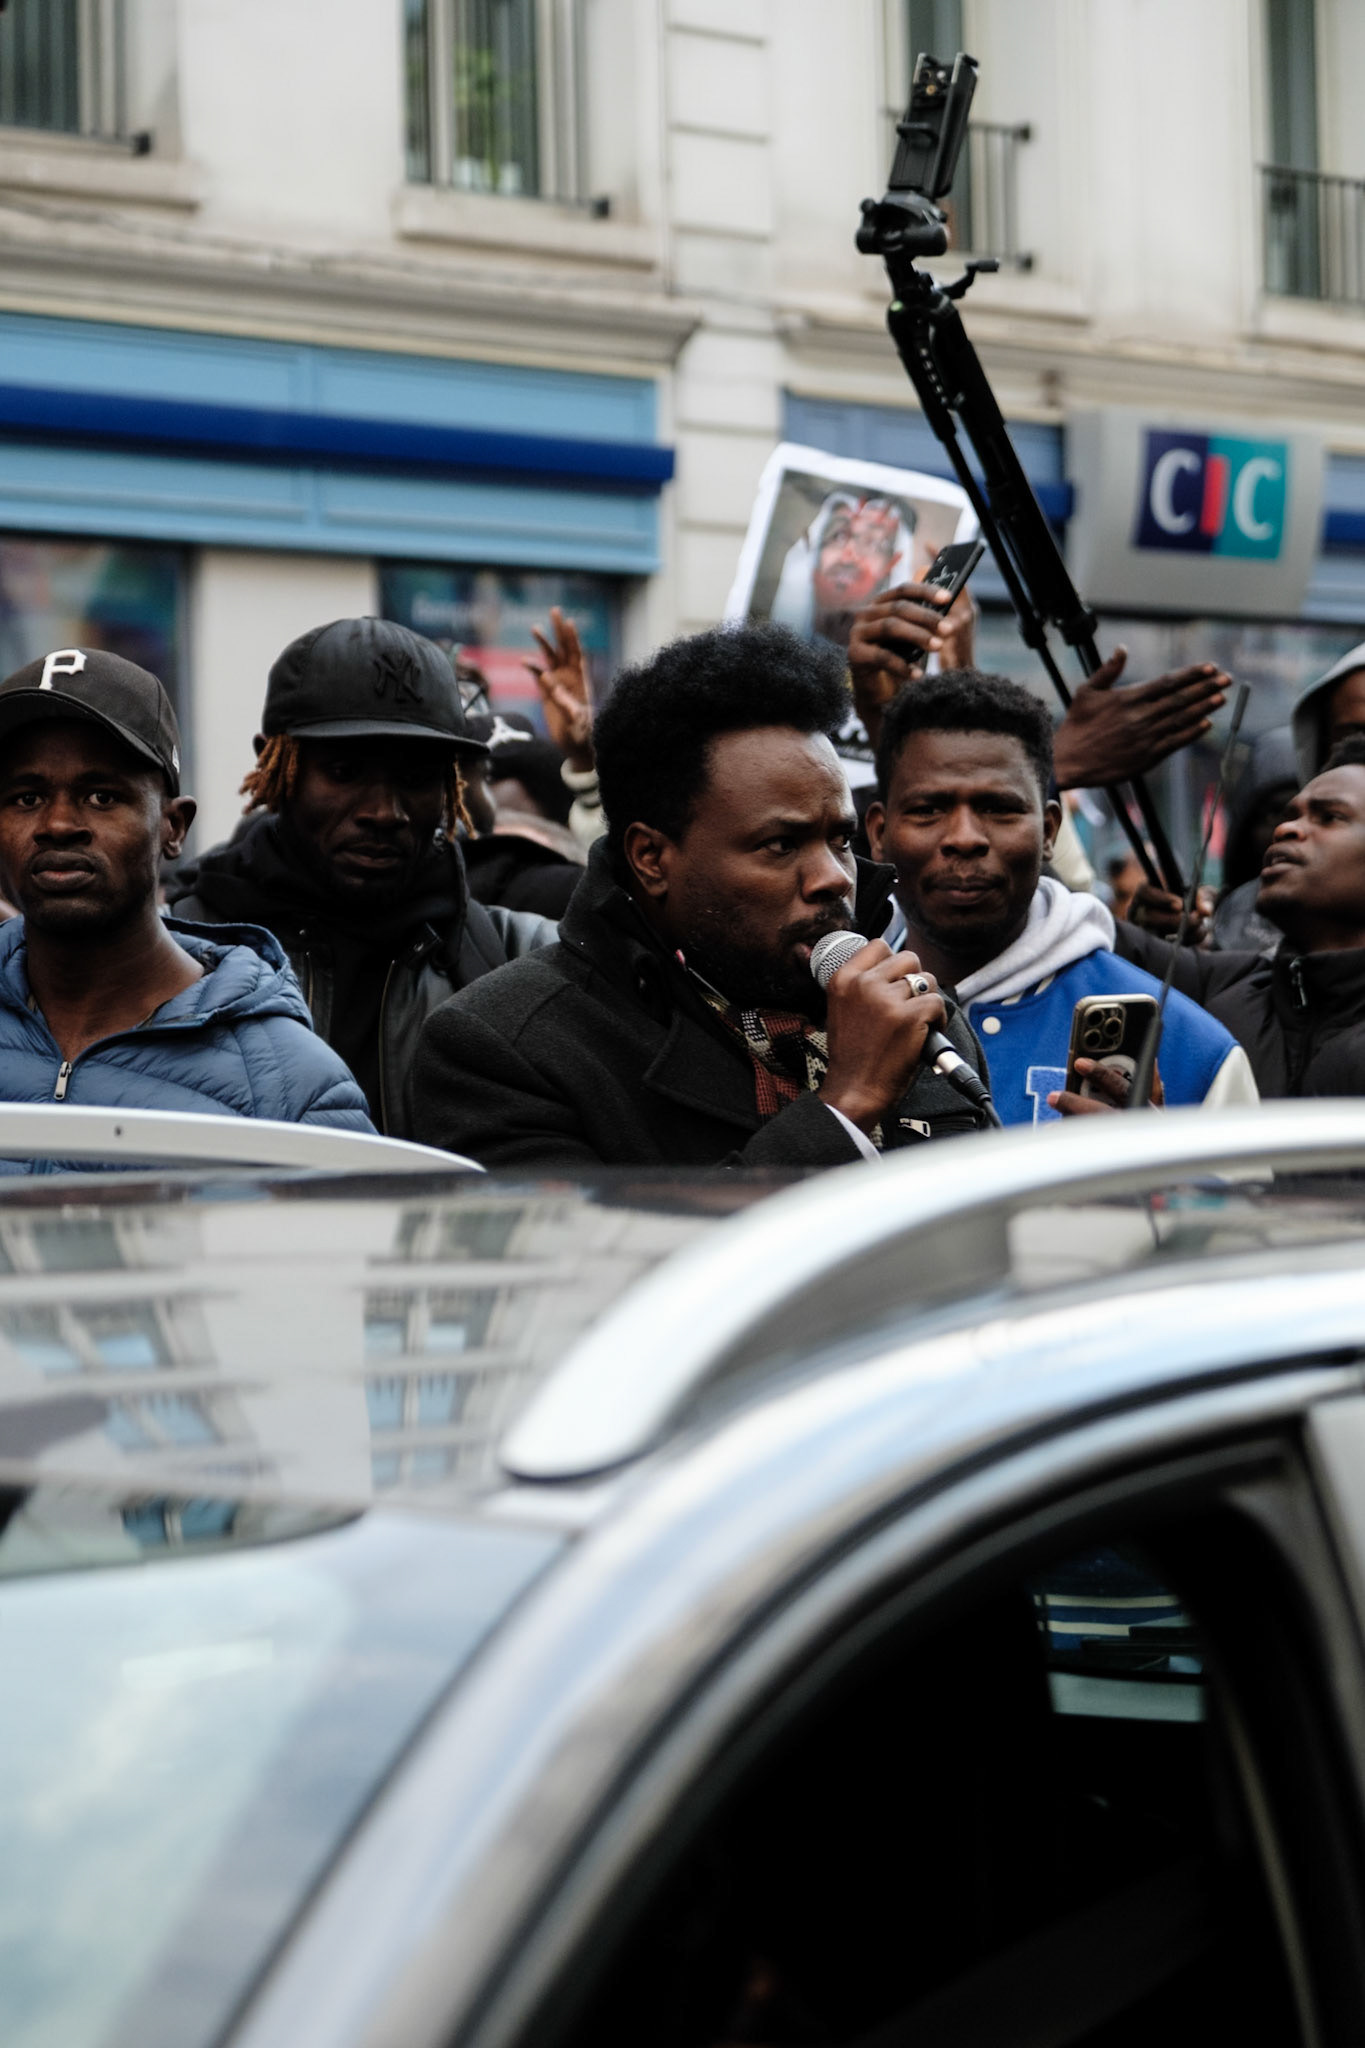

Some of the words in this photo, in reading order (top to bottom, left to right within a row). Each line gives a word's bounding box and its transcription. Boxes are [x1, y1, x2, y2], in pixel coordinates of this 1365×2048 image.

[1150, 448, 1281, 541] CIC
[39, 649, 87, 690] P
[372, 651, 424, 704] NY
